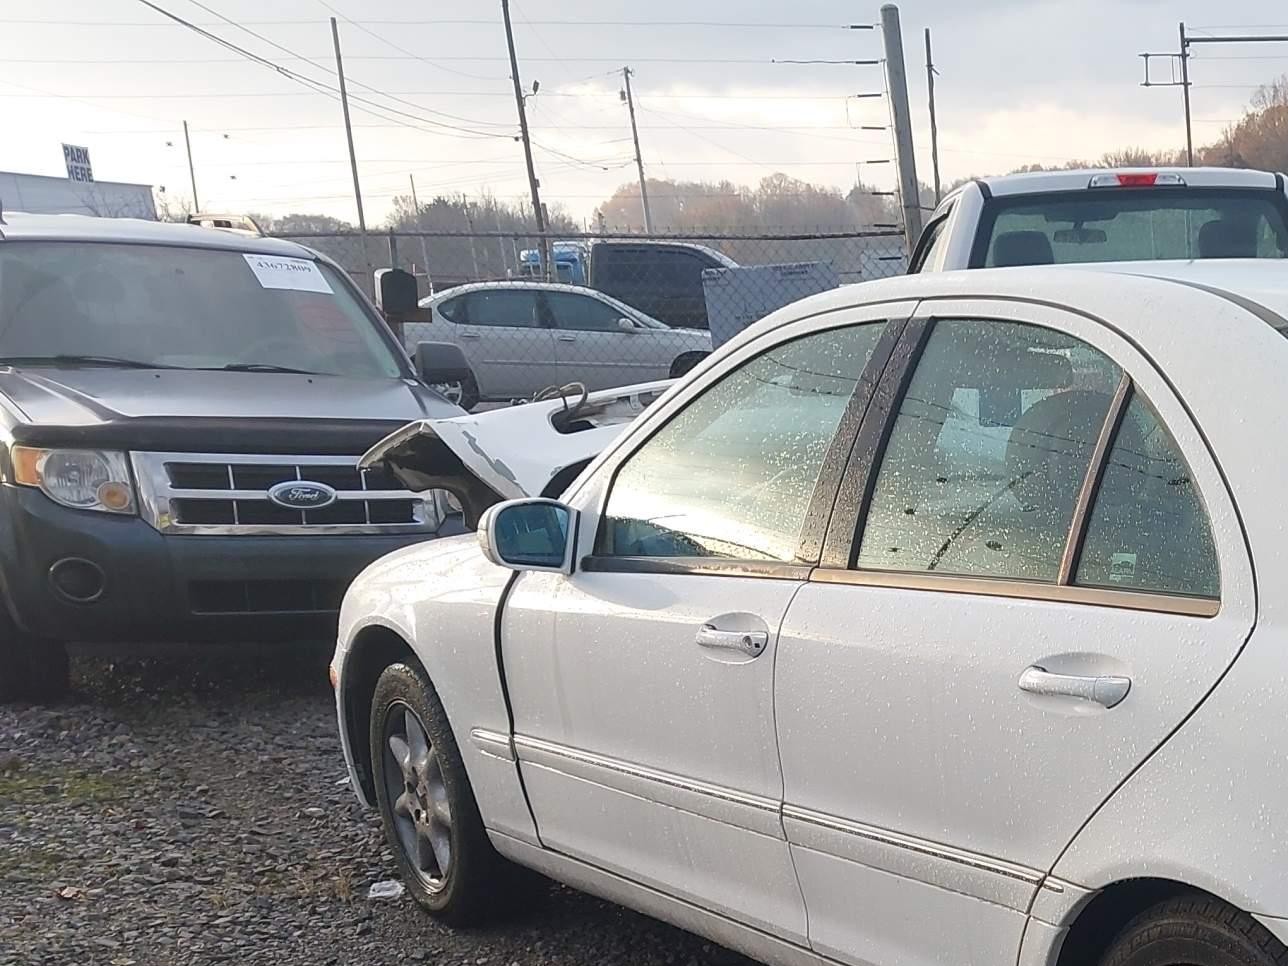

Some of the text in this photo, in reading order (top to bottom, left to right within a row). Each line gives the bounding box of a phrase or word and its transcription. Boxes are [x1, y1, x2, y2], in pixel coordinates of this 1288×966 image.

[63, 145, 91, 165] PARK
[67, 165, 94, 182] HERE
[288, 488, 320, 500] Ford
